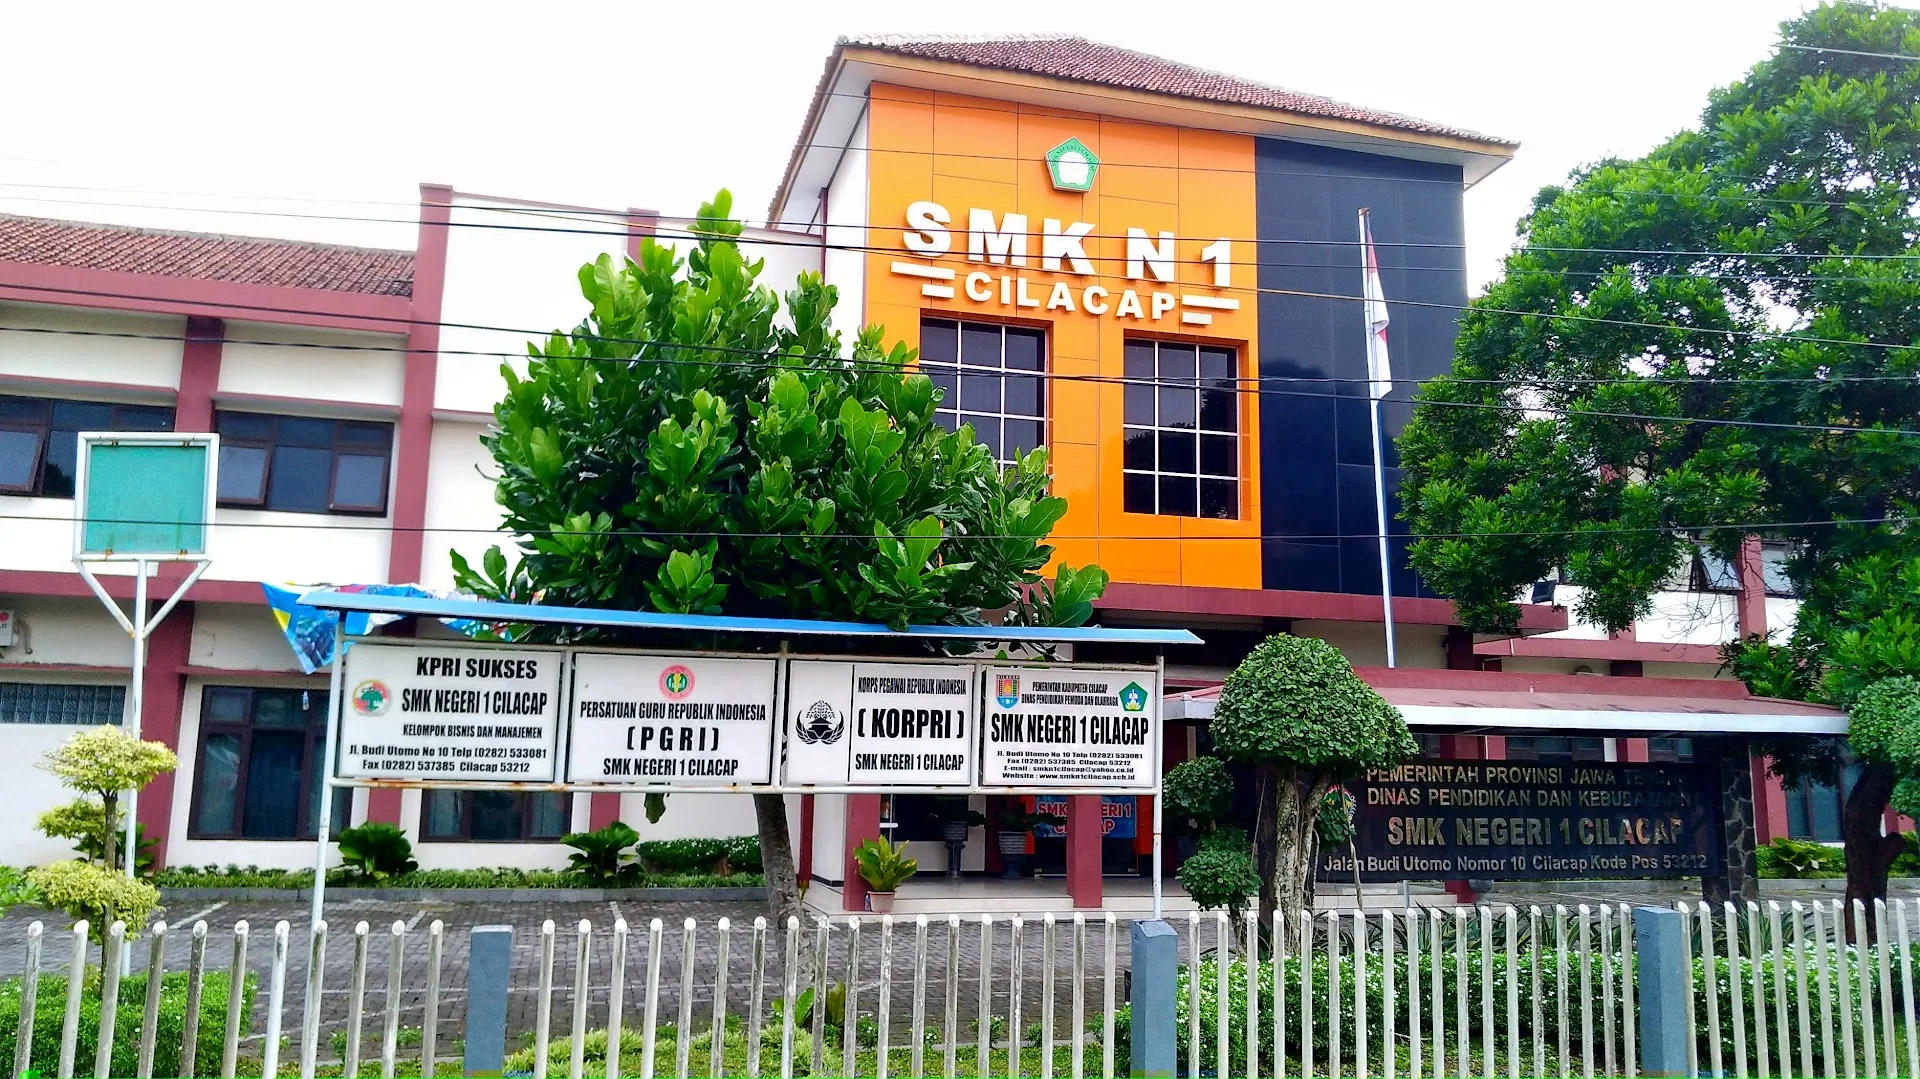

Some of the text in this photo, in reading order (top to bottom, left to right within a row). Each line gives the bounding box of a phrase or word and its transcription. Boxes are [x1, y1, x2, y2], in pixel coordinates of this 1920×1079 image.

[903, 200, 1232, 288] SMK N 1
[965, 271, 1176, 320] CILACAP
[416, 657, 538, 680] KPRI SUKSES
[858, 677, 966, 695] KORPS PEGAWAI REPUBLIK INDONESIA
[1032, 681, 1108, 694] PEMERINTAH KABUPATEN CILACAP
[402, 688, 548, 715] SMK NEGERI 1 CILACAP
[1021, 693, 1036, 704] DINAS
[1036, 694, 1064, 705] PENDIDIKAN
[1084, 695, 1094, 706] DAN
[580, 701, 766, 720] PERSATUAN GURU REPUBLIK INDONESIA
[402, 724, 542, 739] KELOMPOK BISNIS DAN MANAJEMEN
[991, 712, 1149, 746] SMK NEGERI 1 CILACAP
[350, 745, 547, 759] Jl. Budi Utomo No 10 Telp (0282) 533081
[362, 759, 530, 773] Fax (0282) 537385 Cilacap 53212
[604, 758, 738, 776] SMK NEGERI 1 CILACAP
[856, 754, 964, 770] SMK NEGERI 1 CILACAP
[1366, 765, 1479, 784] PEMERINTAH
[1486, 766, 1562, 784] PROVINSI
[1570, 768, 1616, 785] JAWA
[1368, 788, 1421, 806] DINAS
[1429, 788, 1531, 806] PENDIDIKAN
[1537, 790, 1572, 806] DAN
[1388, 816, 1684, 846] SMK NEGERI 1 CILACAP
[1324, 854, 1708, 873] Jalan Budi Utomo Nomor 10 Cilacap Kode Pos 53212
